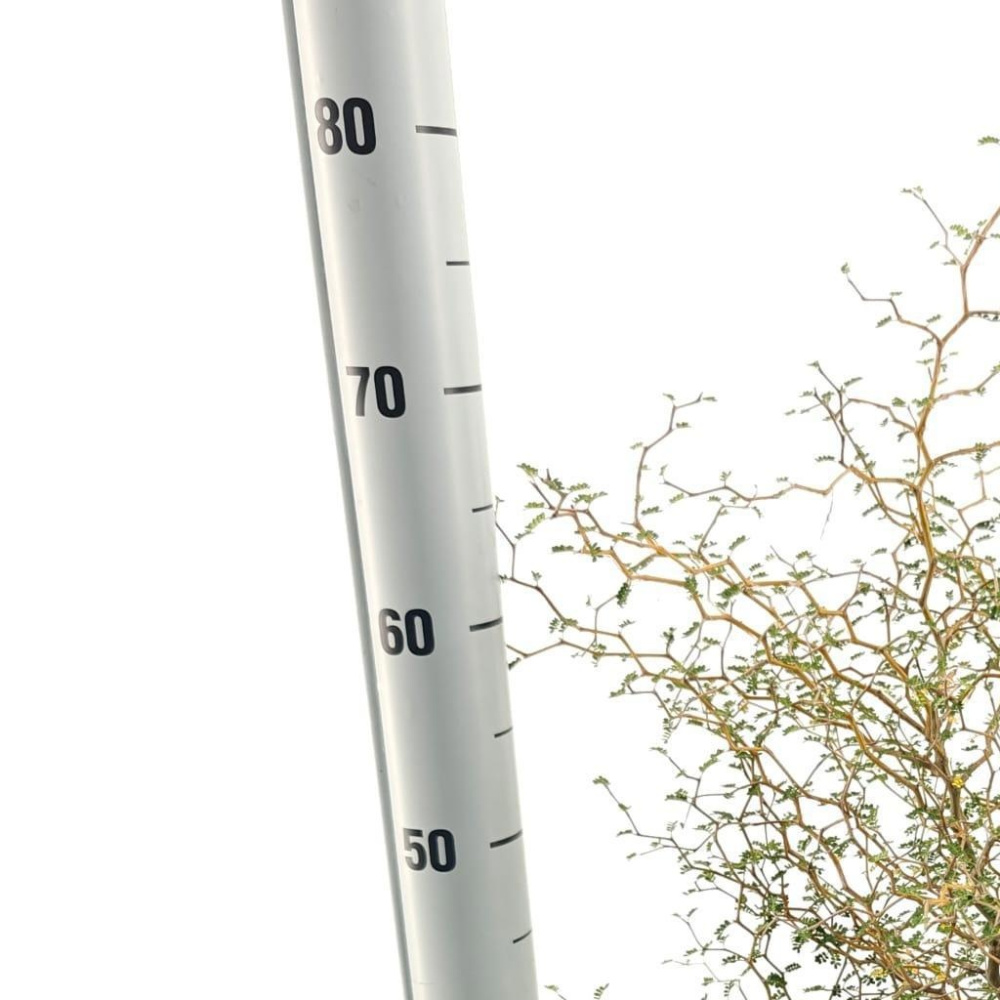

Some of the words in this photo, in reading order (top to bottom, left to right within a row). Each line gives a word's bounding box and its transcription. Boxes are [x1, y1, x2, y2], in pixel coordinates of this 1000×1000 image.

[314, 97, 377, 156] 80
[345, 366, 406, 419] 70
[377, 607, 435, 656] 60
[403, 828, 456, 873] 50
